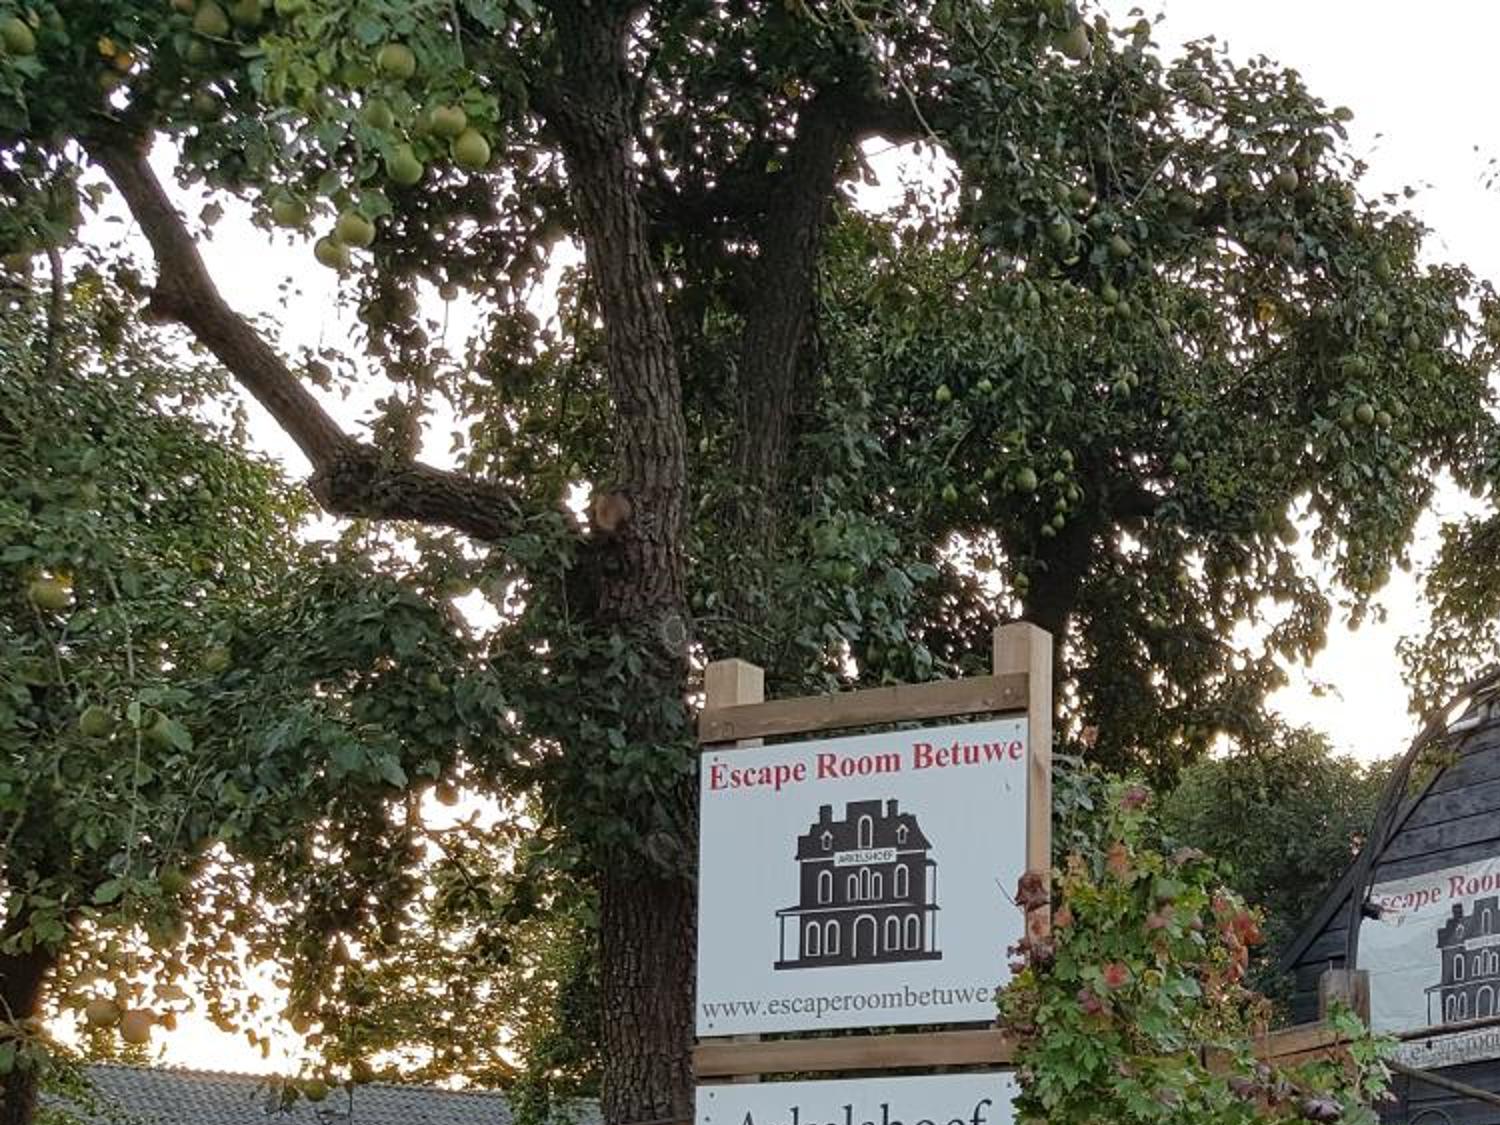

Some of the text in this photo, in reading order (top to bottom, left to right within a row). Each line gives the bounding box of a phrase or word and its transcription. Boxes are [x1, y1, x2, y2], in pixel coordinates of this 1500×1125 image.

[709, 738, 1024, 792] Escape Room Betuwe
[1372, 885, 1441, 912] scape
